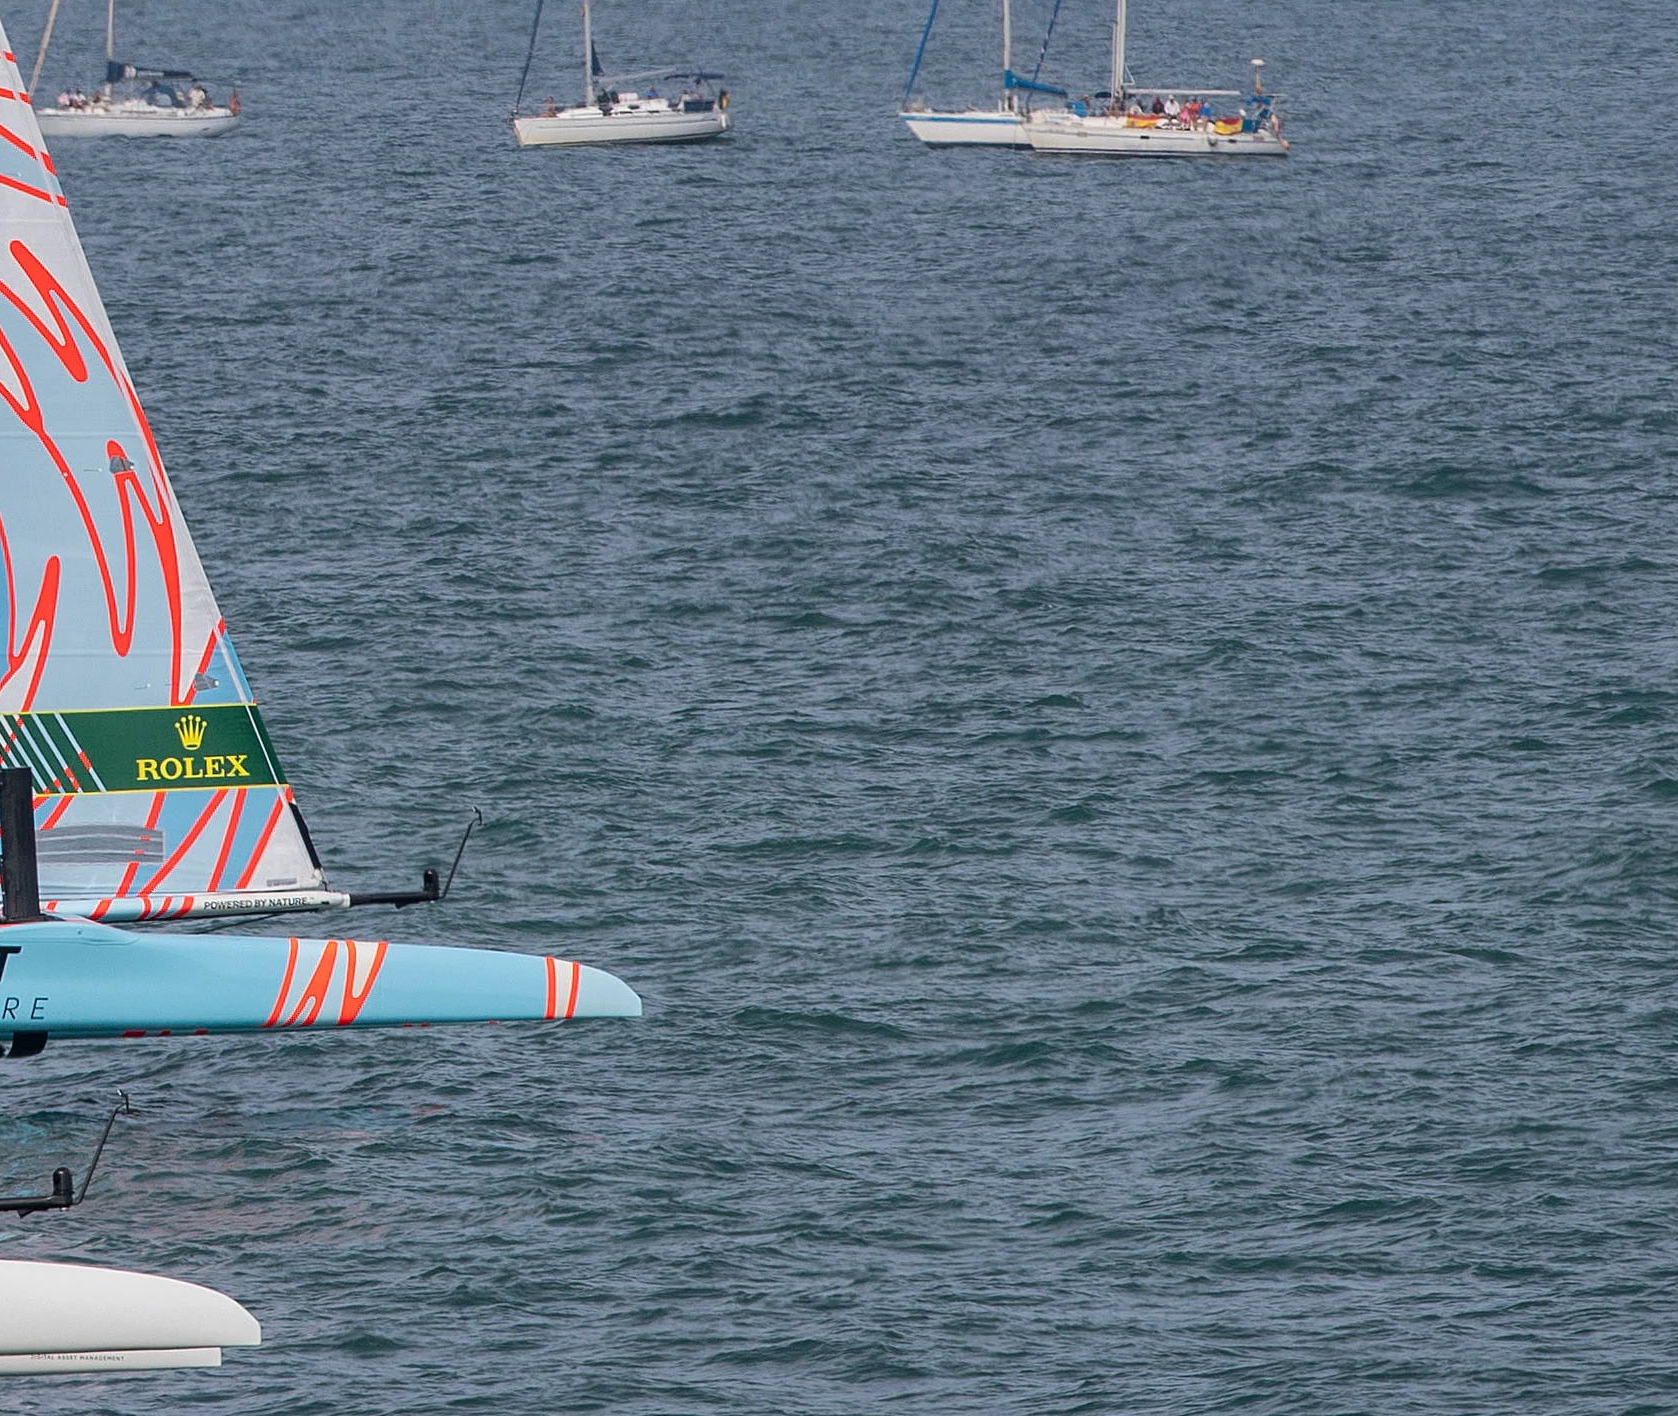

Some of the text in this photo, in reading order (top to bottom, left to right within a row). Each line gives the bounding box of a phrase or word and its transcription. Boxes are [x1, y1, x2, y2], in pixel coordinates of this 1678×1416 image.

[135, 754, 251, 782] ROLEX
[203, 899, 253, 911] POWERED
[254, 898, 267, 909] BY
